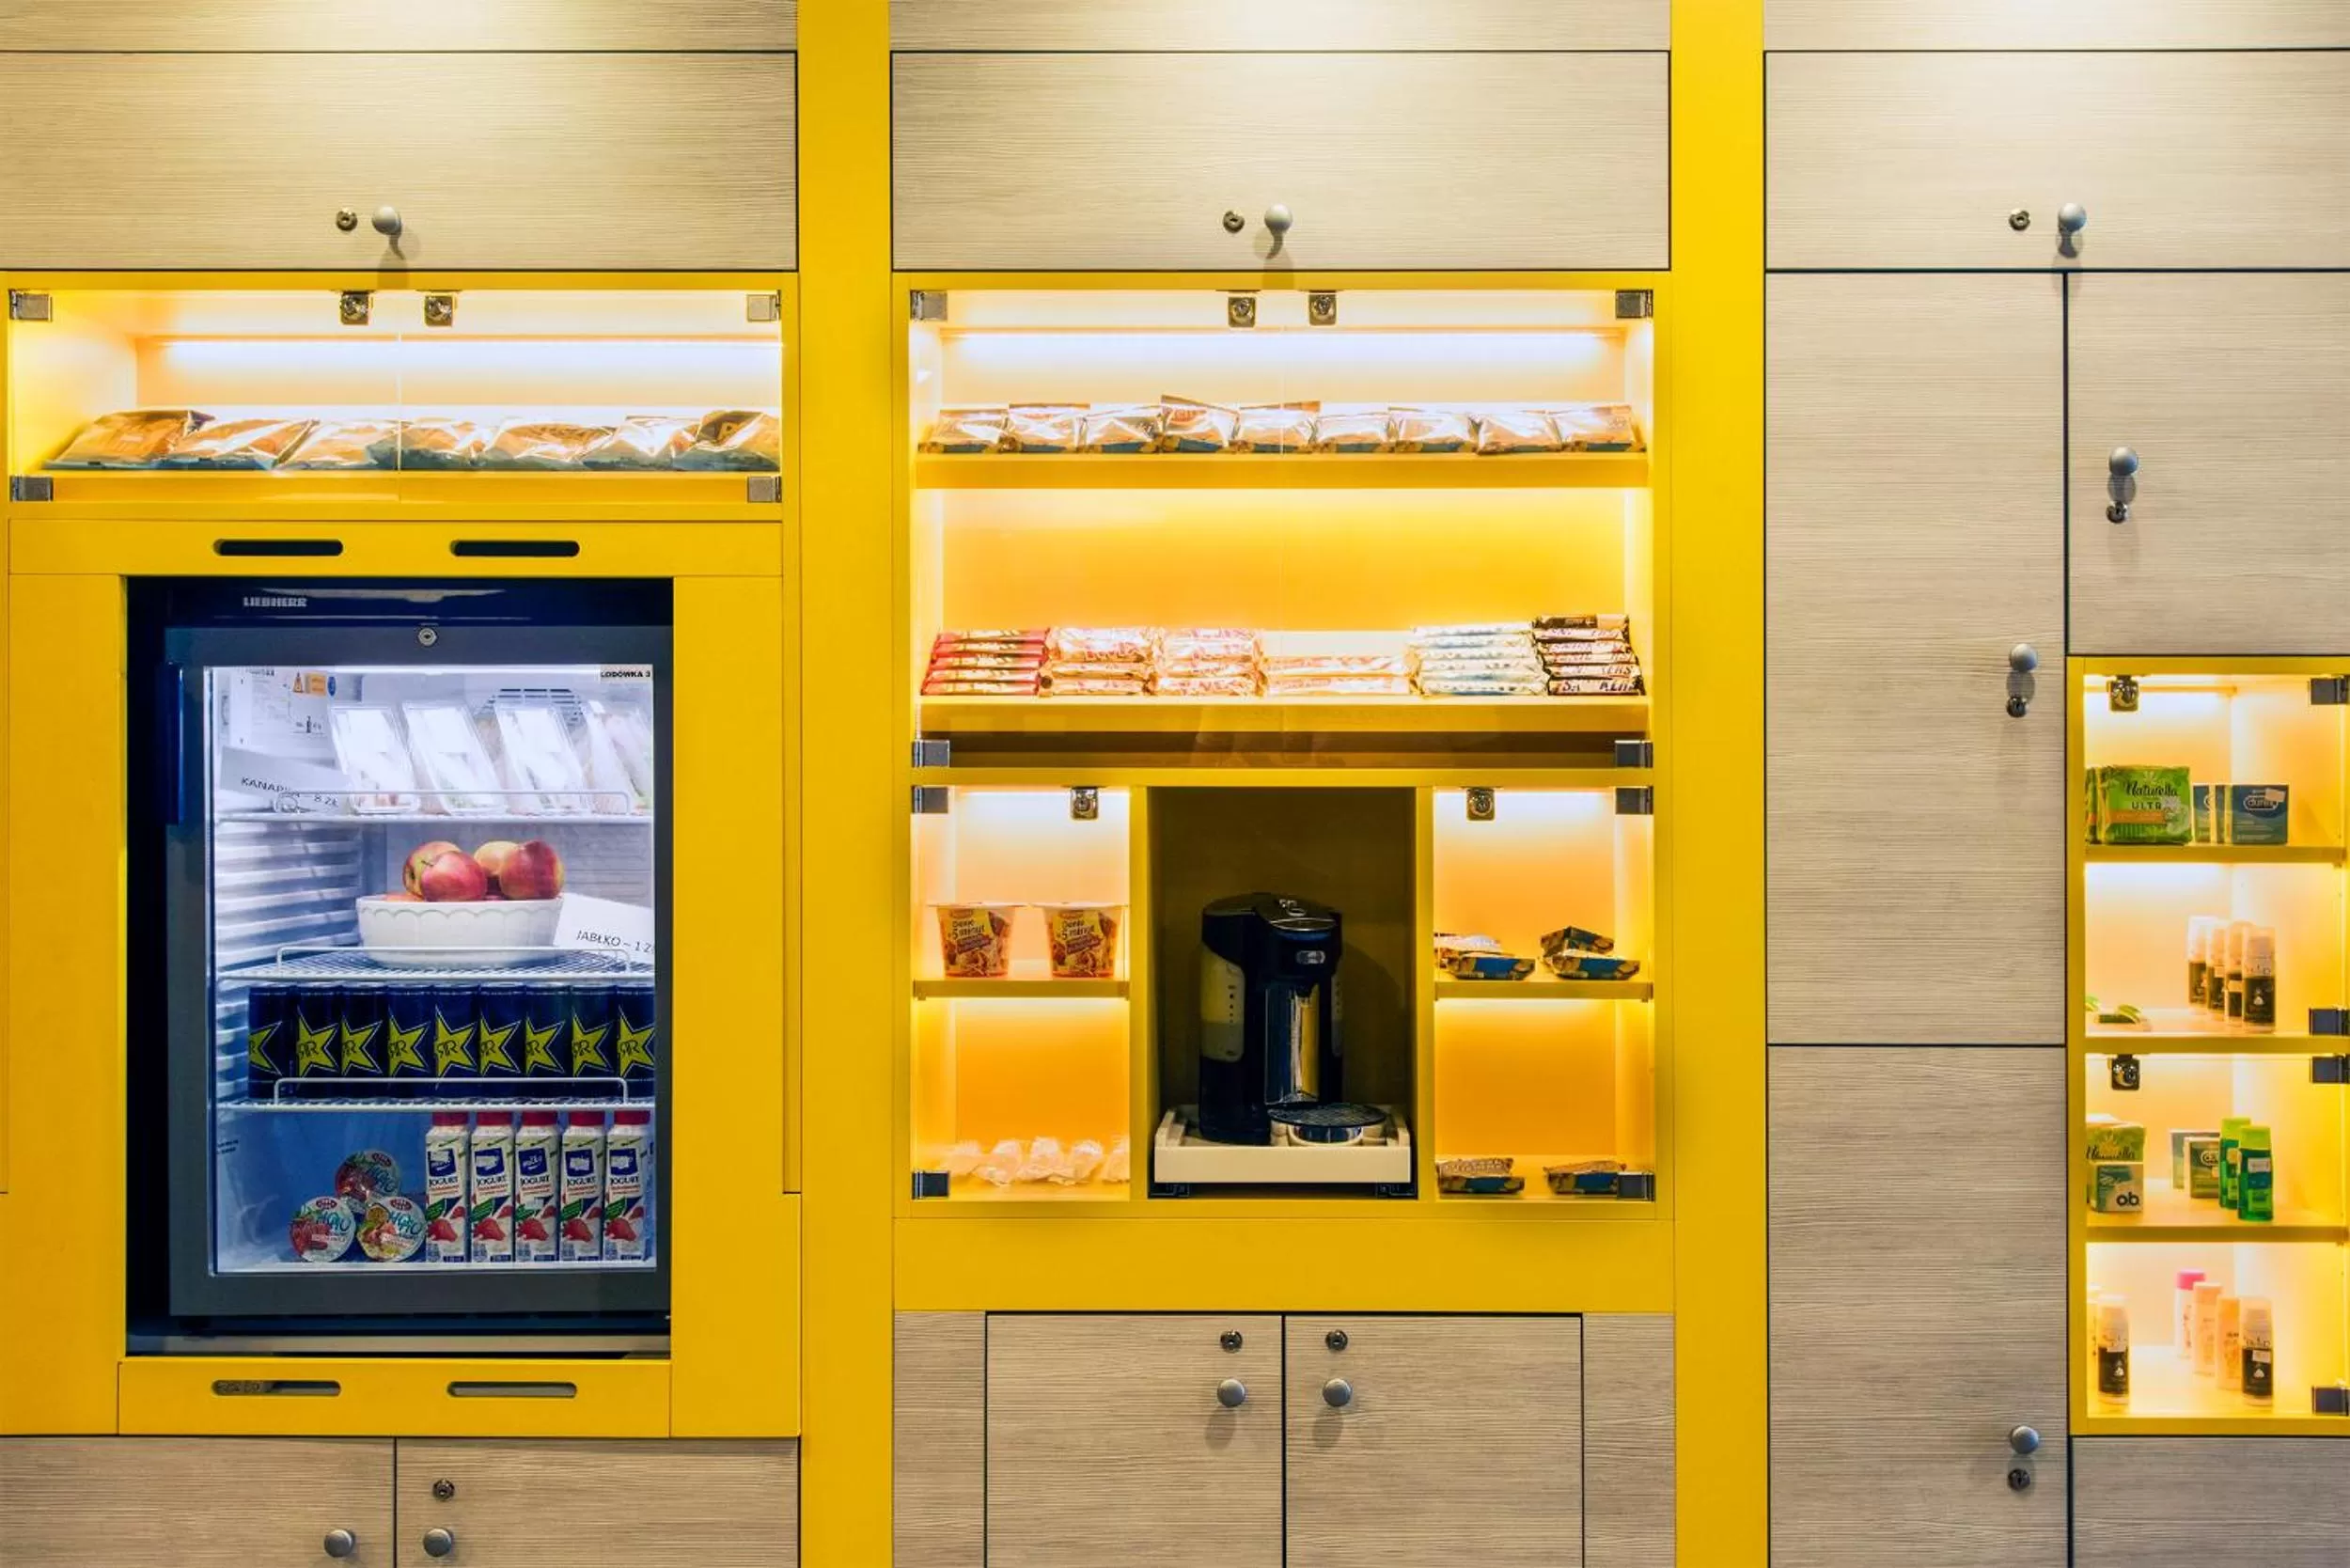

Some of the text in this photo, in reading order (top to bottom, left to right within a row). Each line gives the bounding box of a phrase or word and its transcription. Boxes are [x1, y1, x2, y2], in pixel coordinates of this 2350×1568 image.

[243, 597, 306, 607] LIEBHERR
[2125, 780, 2178, 798] Naturella
[576, 929, 621, 947] JABŁKO
